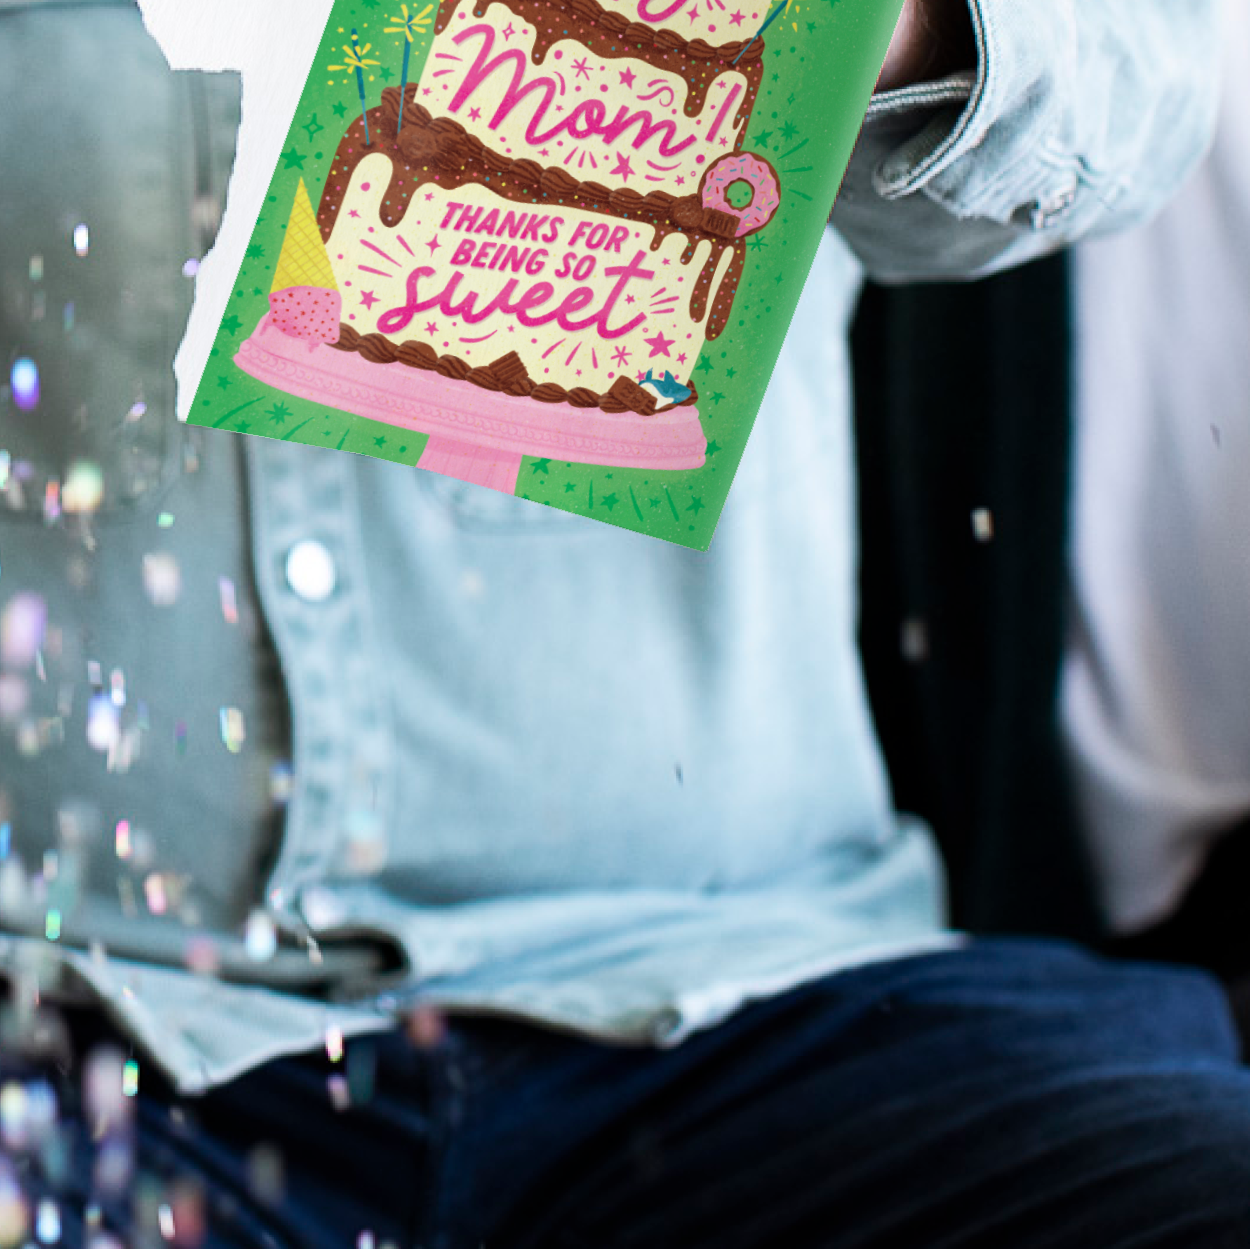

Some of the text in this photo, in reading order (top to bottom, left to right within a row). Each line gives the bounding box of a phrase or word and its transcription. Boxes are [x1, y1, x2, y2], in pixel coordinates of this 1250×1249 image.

[448, 23, 742, 164] Mom!
[439, 202, 630, 253] THANKS FOR
[450, 238, 596, 281] BEING SO
[376, 250, 655, 339] sweet
